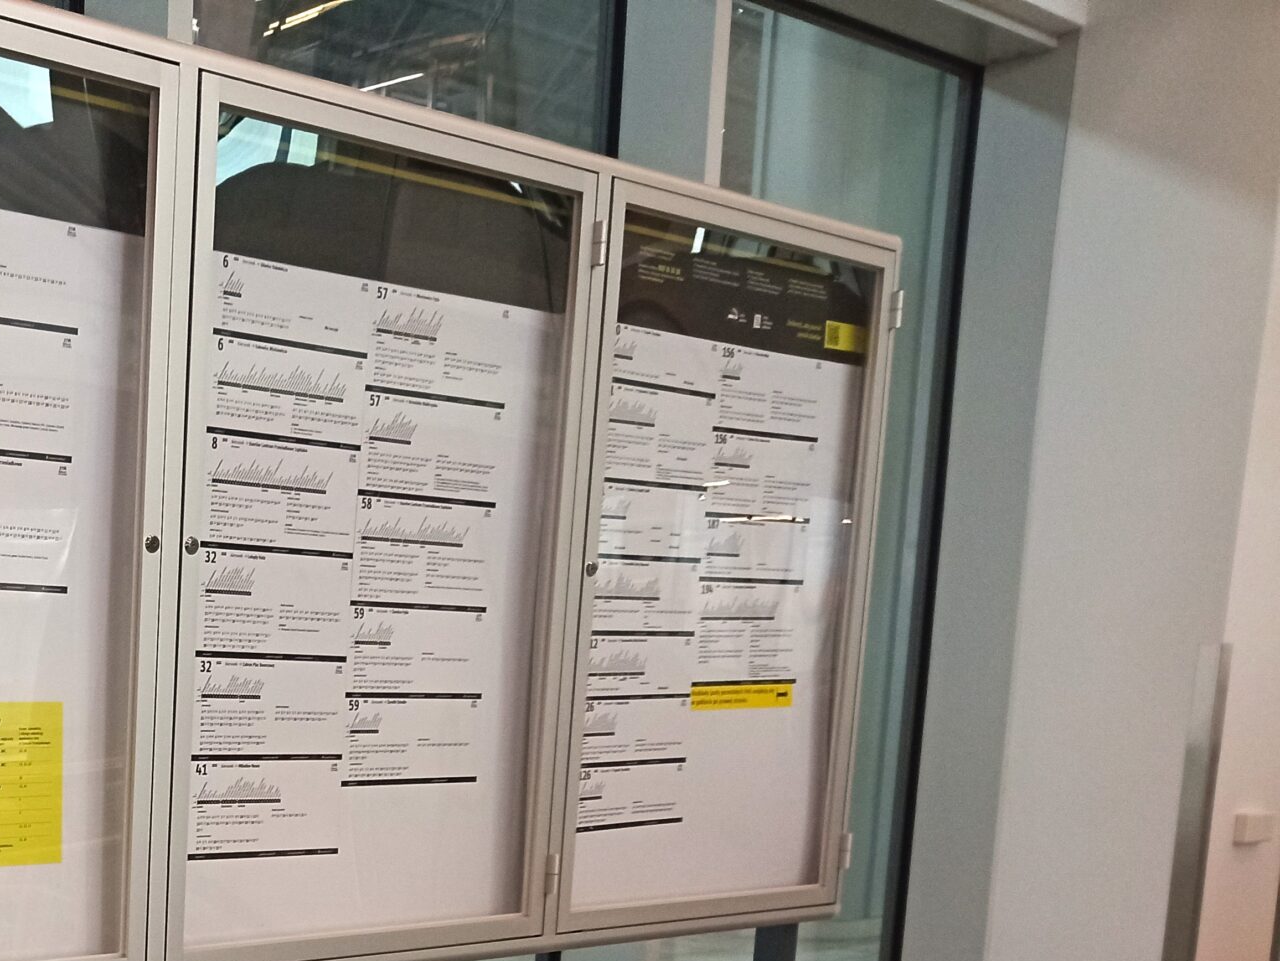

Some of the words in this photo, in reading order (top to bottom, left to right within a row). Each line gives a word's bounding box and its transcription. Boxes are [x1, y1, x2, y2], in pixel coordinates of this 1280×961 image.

[223, 255, 229, 268] 6
[376, 286, 389, 300] 57
[217, 338, 224, 351] 6
[369, 394, 381, 407] 57
[211, 436, 218, 449] 8
[360, 497, 373, 510] 58
[204, 551, 217, 563] 32
[353, 607, 365, 619] 59
[200, 660, 212, 672] 32
[348, 699, 360, 711] 59
[195, 763, 208, 776] 41
